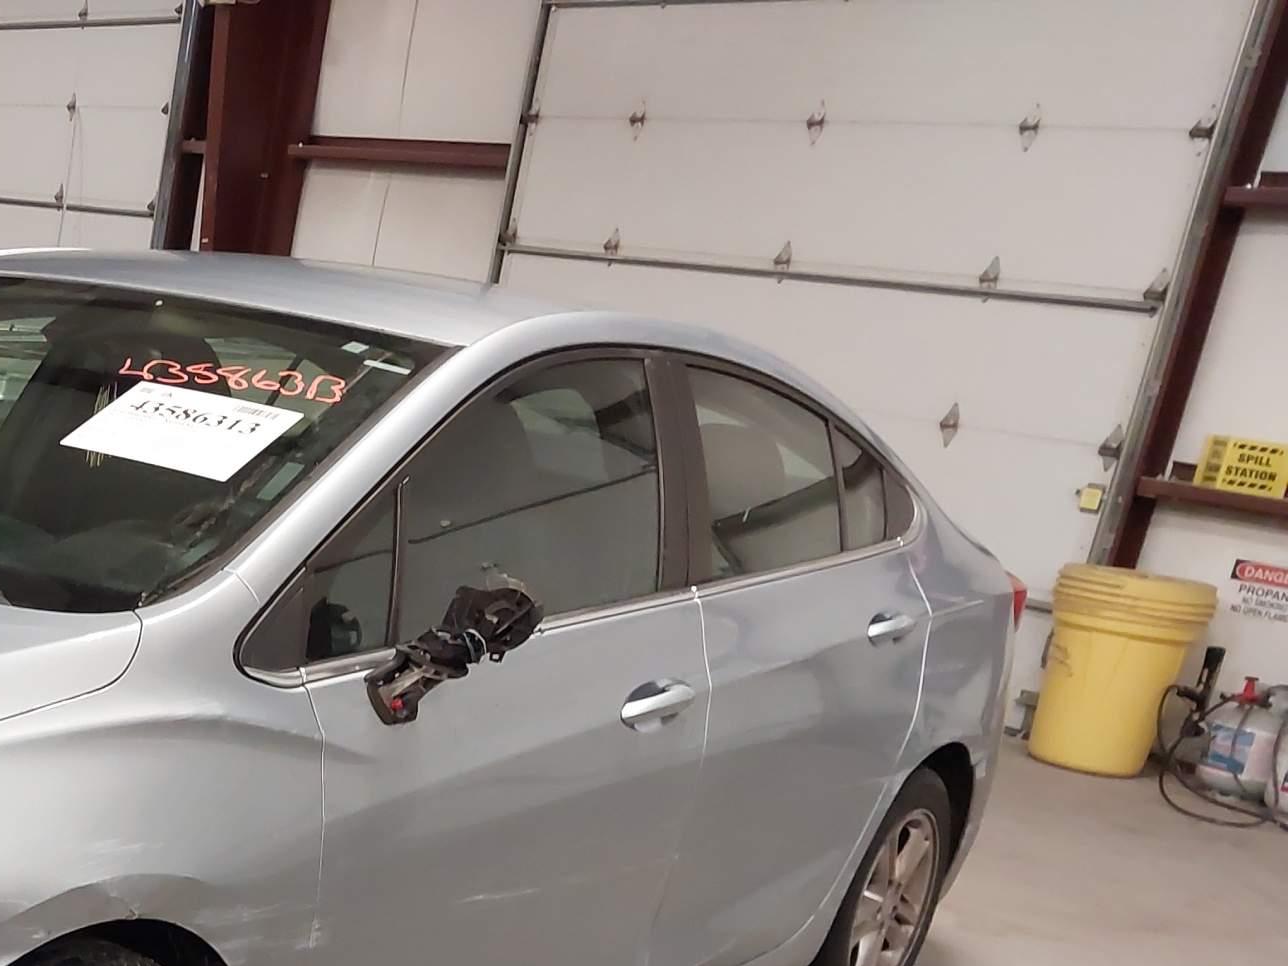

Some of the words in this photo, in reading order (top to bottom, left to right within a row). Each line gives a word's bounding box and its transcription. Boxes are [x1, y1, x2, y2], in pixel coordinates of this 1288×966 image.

[130, 399, 262, 435] 43586313
[1237, 452, 1272, 468] SPILL
[1225, 464, 1278, 482] STATION
